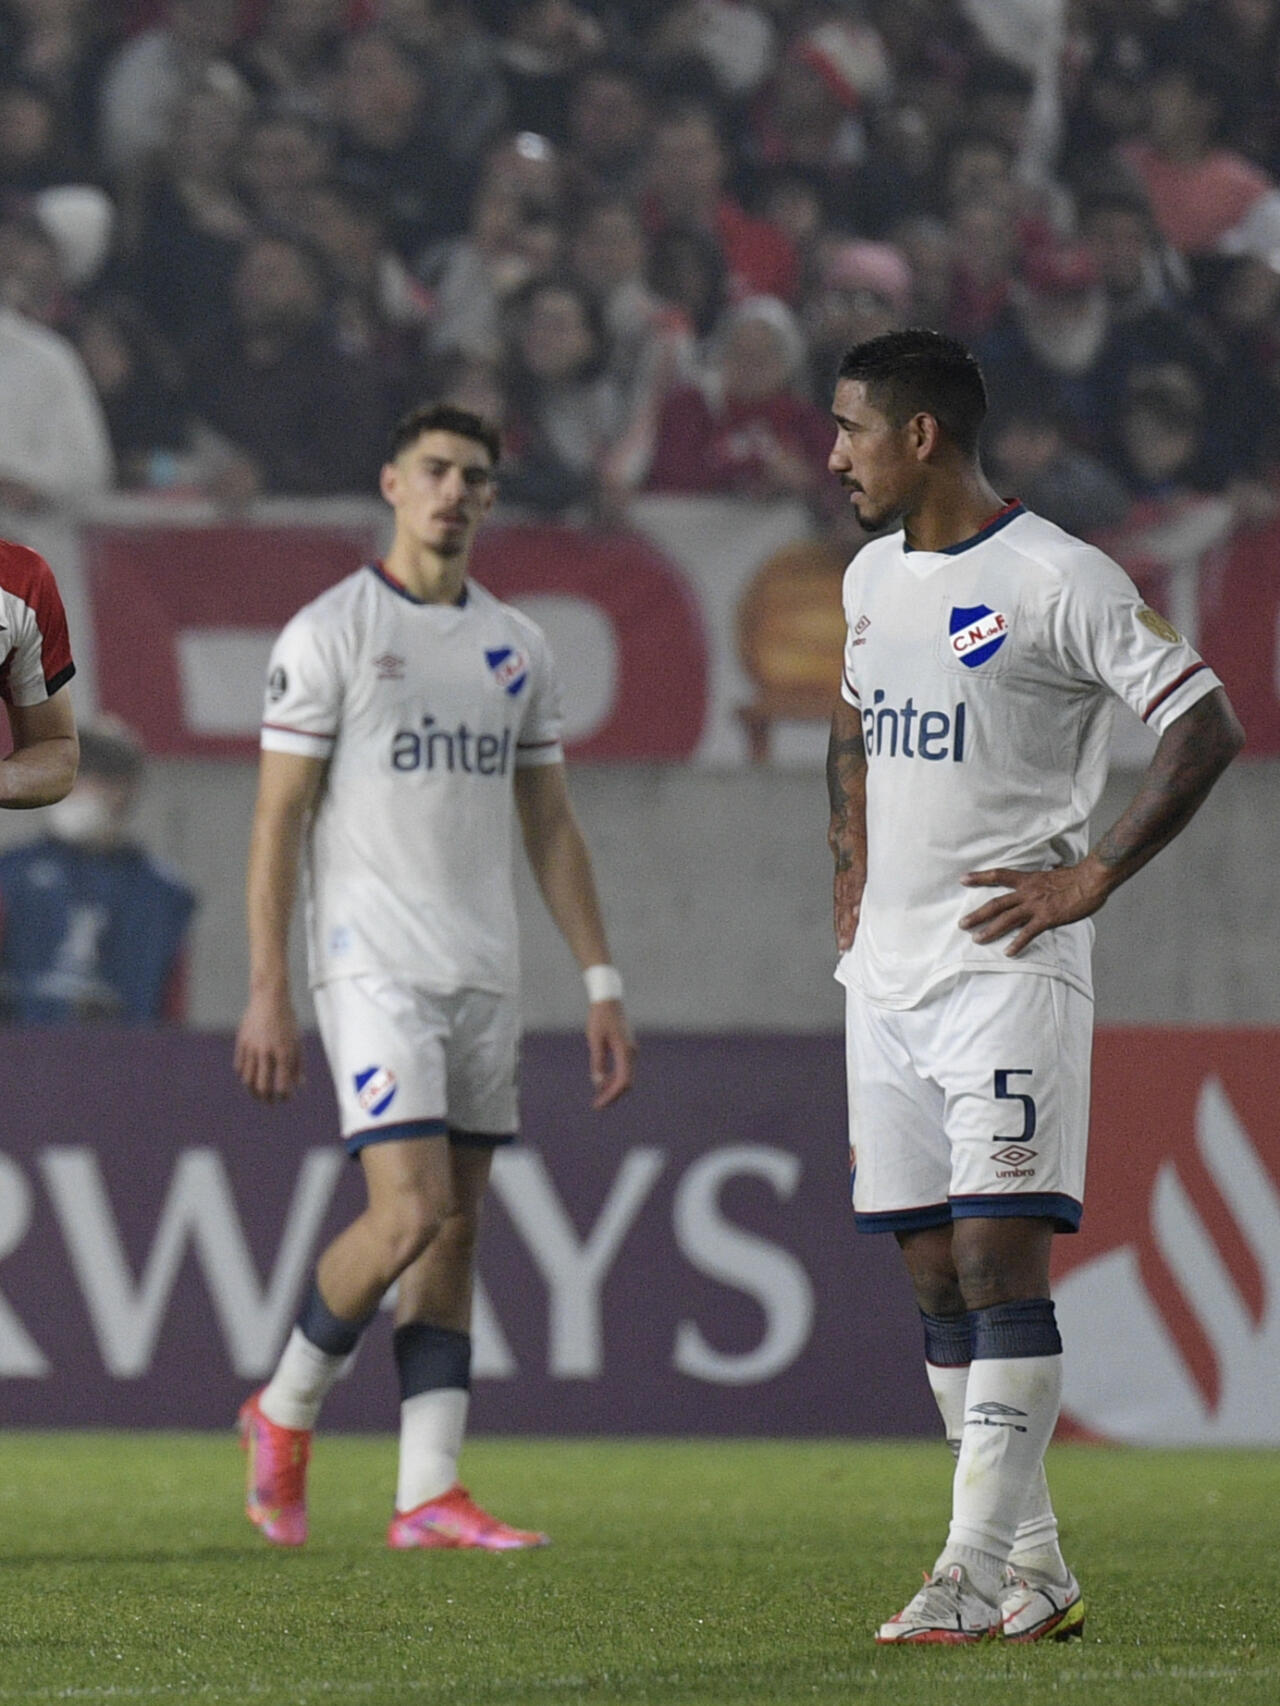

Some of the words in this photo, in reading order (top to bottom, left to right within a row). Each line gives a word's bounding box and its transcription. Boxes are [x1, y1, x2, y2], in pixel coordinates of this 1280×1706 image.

[392, 716, 510, 775] antel
[863, 689, 966, 763] antel
[992, 1069, 1037, 1142] 5
[995, 1167, 1036, 1179] umbro
